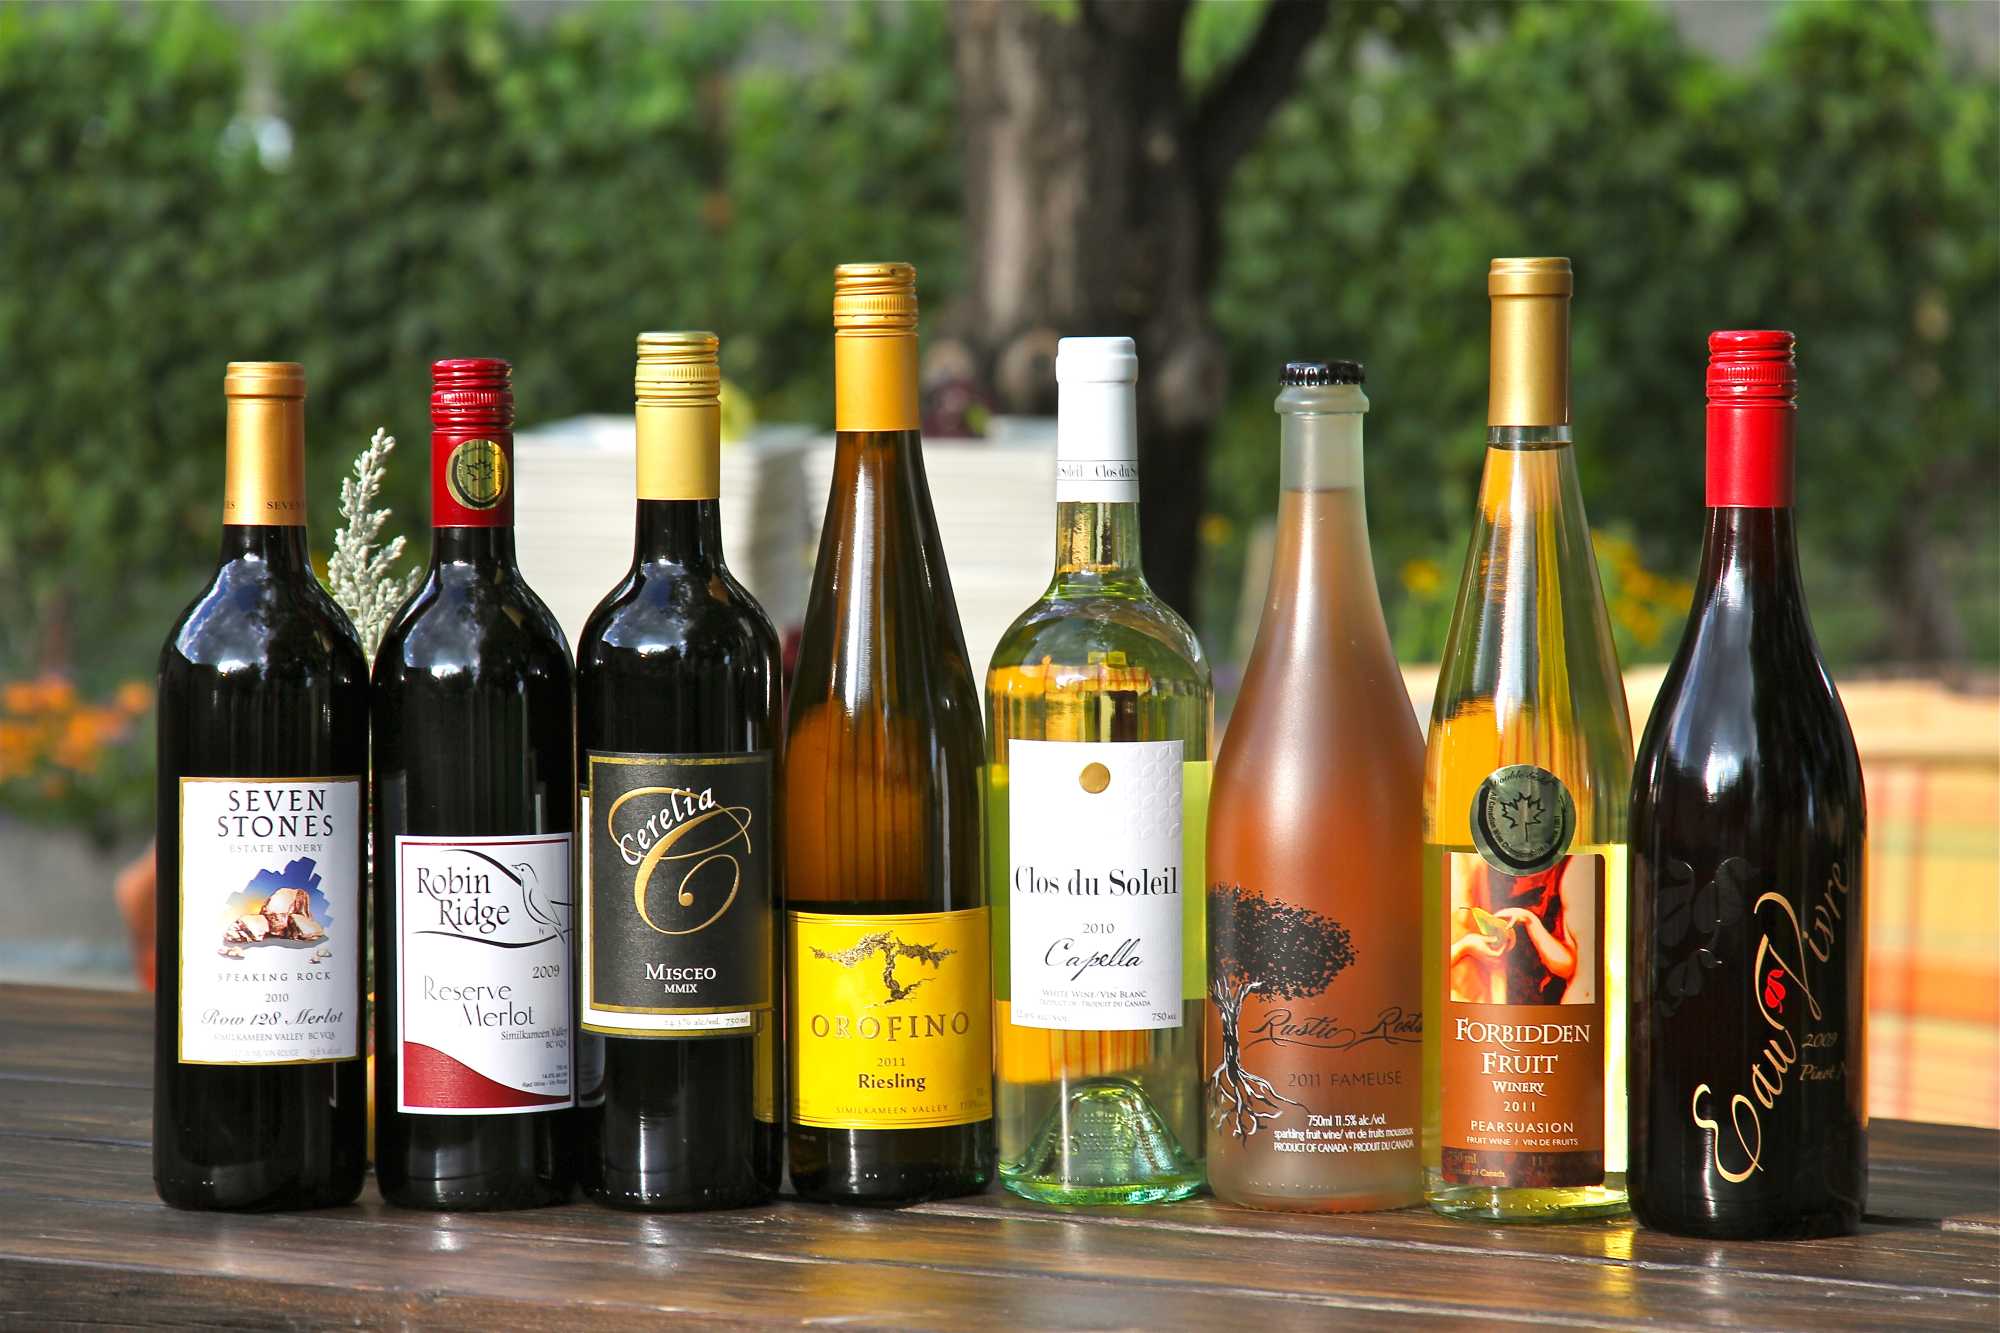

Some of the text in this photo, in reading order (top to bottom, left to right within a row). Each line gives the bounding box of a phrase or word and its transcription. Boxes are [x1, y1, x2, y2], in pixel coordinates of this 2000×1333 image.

[1095, 464, 1116, 478] Clos
[229, 789, 327, 812] SEVEN
[217, 814, 333, 838] STONES
[619, 786, 717, 867] Cerelia
[229, 843, 323, 854] ESTATE WINERY
[416, 867, 492, 900] Robin
[1015, 866, 1179, 897] Clos du Soleil
[439, 897, 511, 934] Ridge
[1082, 923, 1115, 934] 2010
[1045, 937, 1143, 982] Capella
[217, 971, 332, 982] SPEAKING ROCK
[532, 965, 560, 979] 2009
[424, 975, 512, 1001] Reserve
[664, 983, 698, 994] MMIX
[1120, 990, 1147, 999] BLANC
[265, 993, 289, 1003] 2010
[1124, 1000, 1151, 1008] CANADA
[201, 1007, 344, 1026] Row 128 Merlot
[462, 1001, 535, 1027] Merlot
[1152, 1013, 1166, 1021] 750
[811, 1012, 969, 1041] OROFINO
[1248, 1008, 1356, 1047] Rustic
[275, 1032, 304, 1041] VALLEY
[501, 1029, 549, 1041] Similkameen
[1455, 1017, 1591, 1052] FORBIDDEN
[876, 1058, 906, 1067] 2011
[1481, 1051, 1558, 1074] FRUIT
[858, 1073, 926, 1092] Riesling
[1288, 1071, 1401, 1087] 2011 FAMEUSE
[1492, 1080, 1547, 1096] WINERY
[912, 1104, 948, 1113] VALLEY
[1503, 1101, 1536, 1112] 2011
[1308, 1115, 1333, 1126] 750ml
[1335, 1114, 1357, 1126] 11.5%
[1471, 1120, 1574, 1133] PEARSUASION
[1274, 1128, 1304, 1141] sparkling
[1306, 1129, 1322, 1139] fruit
[1345, 1129, 1356, 1139] vin
[1357, 1129, 1367, 1139] de
[1368, 1128, 1384, 1138] fruits
[1467, 1136, 1487, 1144] FRUIT
[1489, 1137, 1511, 1146] WINE
[1523, 1138, 1537, 1146] VIN
[1539, 1138, 1551, 1146] DE
[1552, 1138, 1578, 1146] FRUITS
[1274, 1142, 1306, 1152] PRODUCT
[1307, 1142, 1317, 1152] OF
[1318, 1142, 1348, 1152] CANADA
[1354, 1141, 1380, 1152] PRODUIT
[1381, 1141, 1391, 1151] DU
